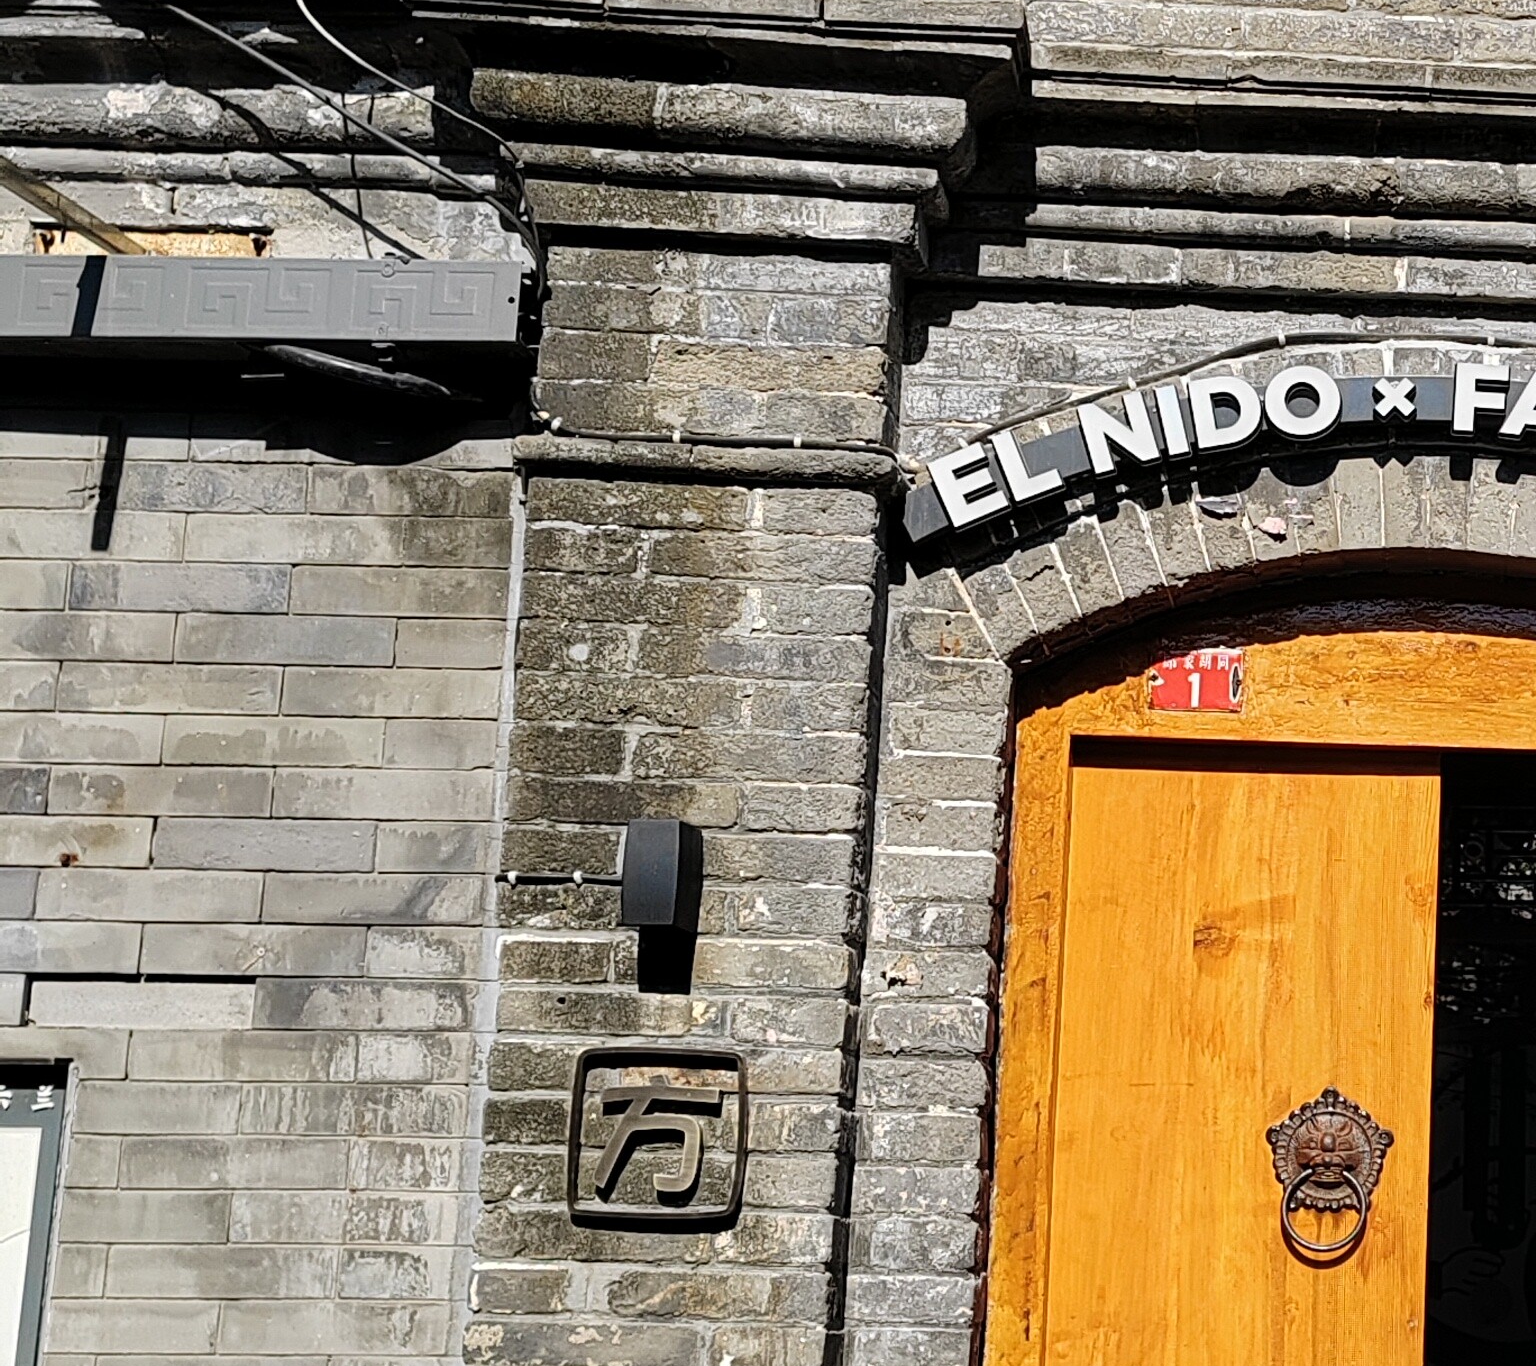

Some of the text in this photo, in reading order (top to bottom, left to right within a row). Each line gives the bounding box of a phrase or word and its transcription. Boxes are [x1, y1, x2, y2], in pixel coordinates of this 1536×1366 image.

[929, 441, 1063, 528] EL
[1077, 365, 1341, 474] NIDO
[1187, 672, 1201, 708] 1
